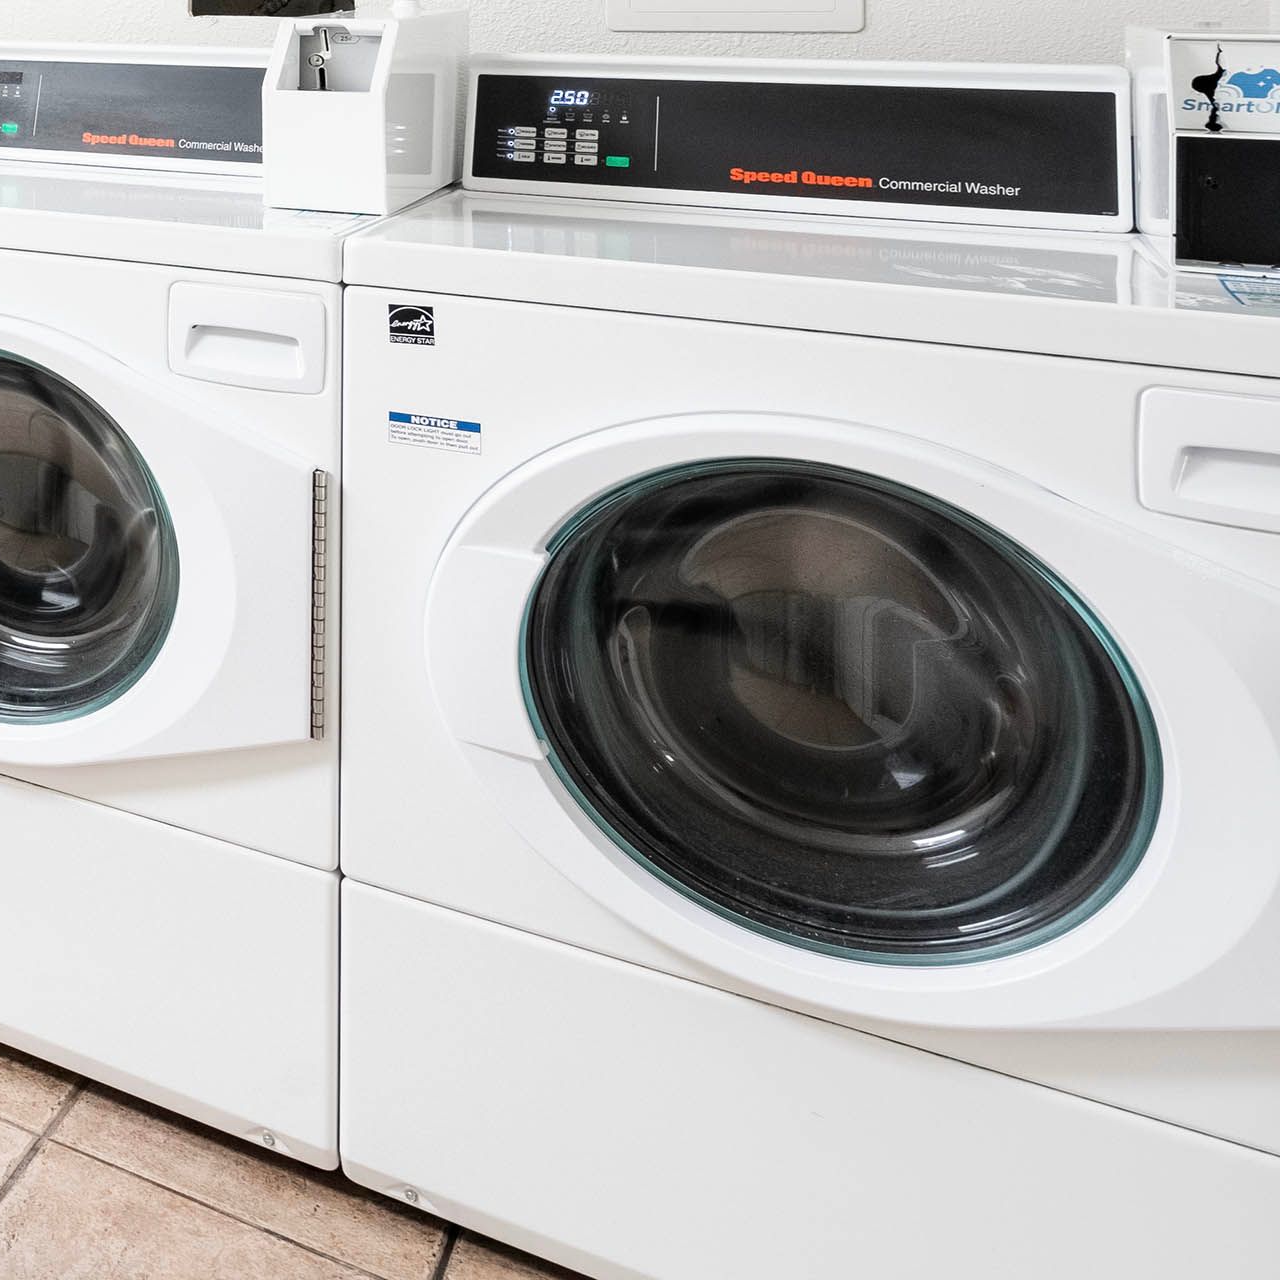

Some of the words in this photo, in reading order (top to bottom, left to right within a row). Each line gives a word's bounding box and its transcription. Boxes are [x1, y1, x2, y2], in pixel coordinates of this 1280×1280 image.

[1181, 98, 1280, 114] SmartO
[82, 132, 126, 144] Speed
[129, 134, 175, 148] Queen
[178, 138, 232, 151] Commercial
[234, 142, 263, 153] Washe
[729, 167, 798, 185] Speed
[801, 170, 873, 188] Queen
[878, 177, 962, 194] Commercial
[965, 182, 1021, 197] Washer
[390, 335, 416, 344] ENERGY
[417, 337, 435, 345] STAR
[411, 415, 458, 429] NOTICE
